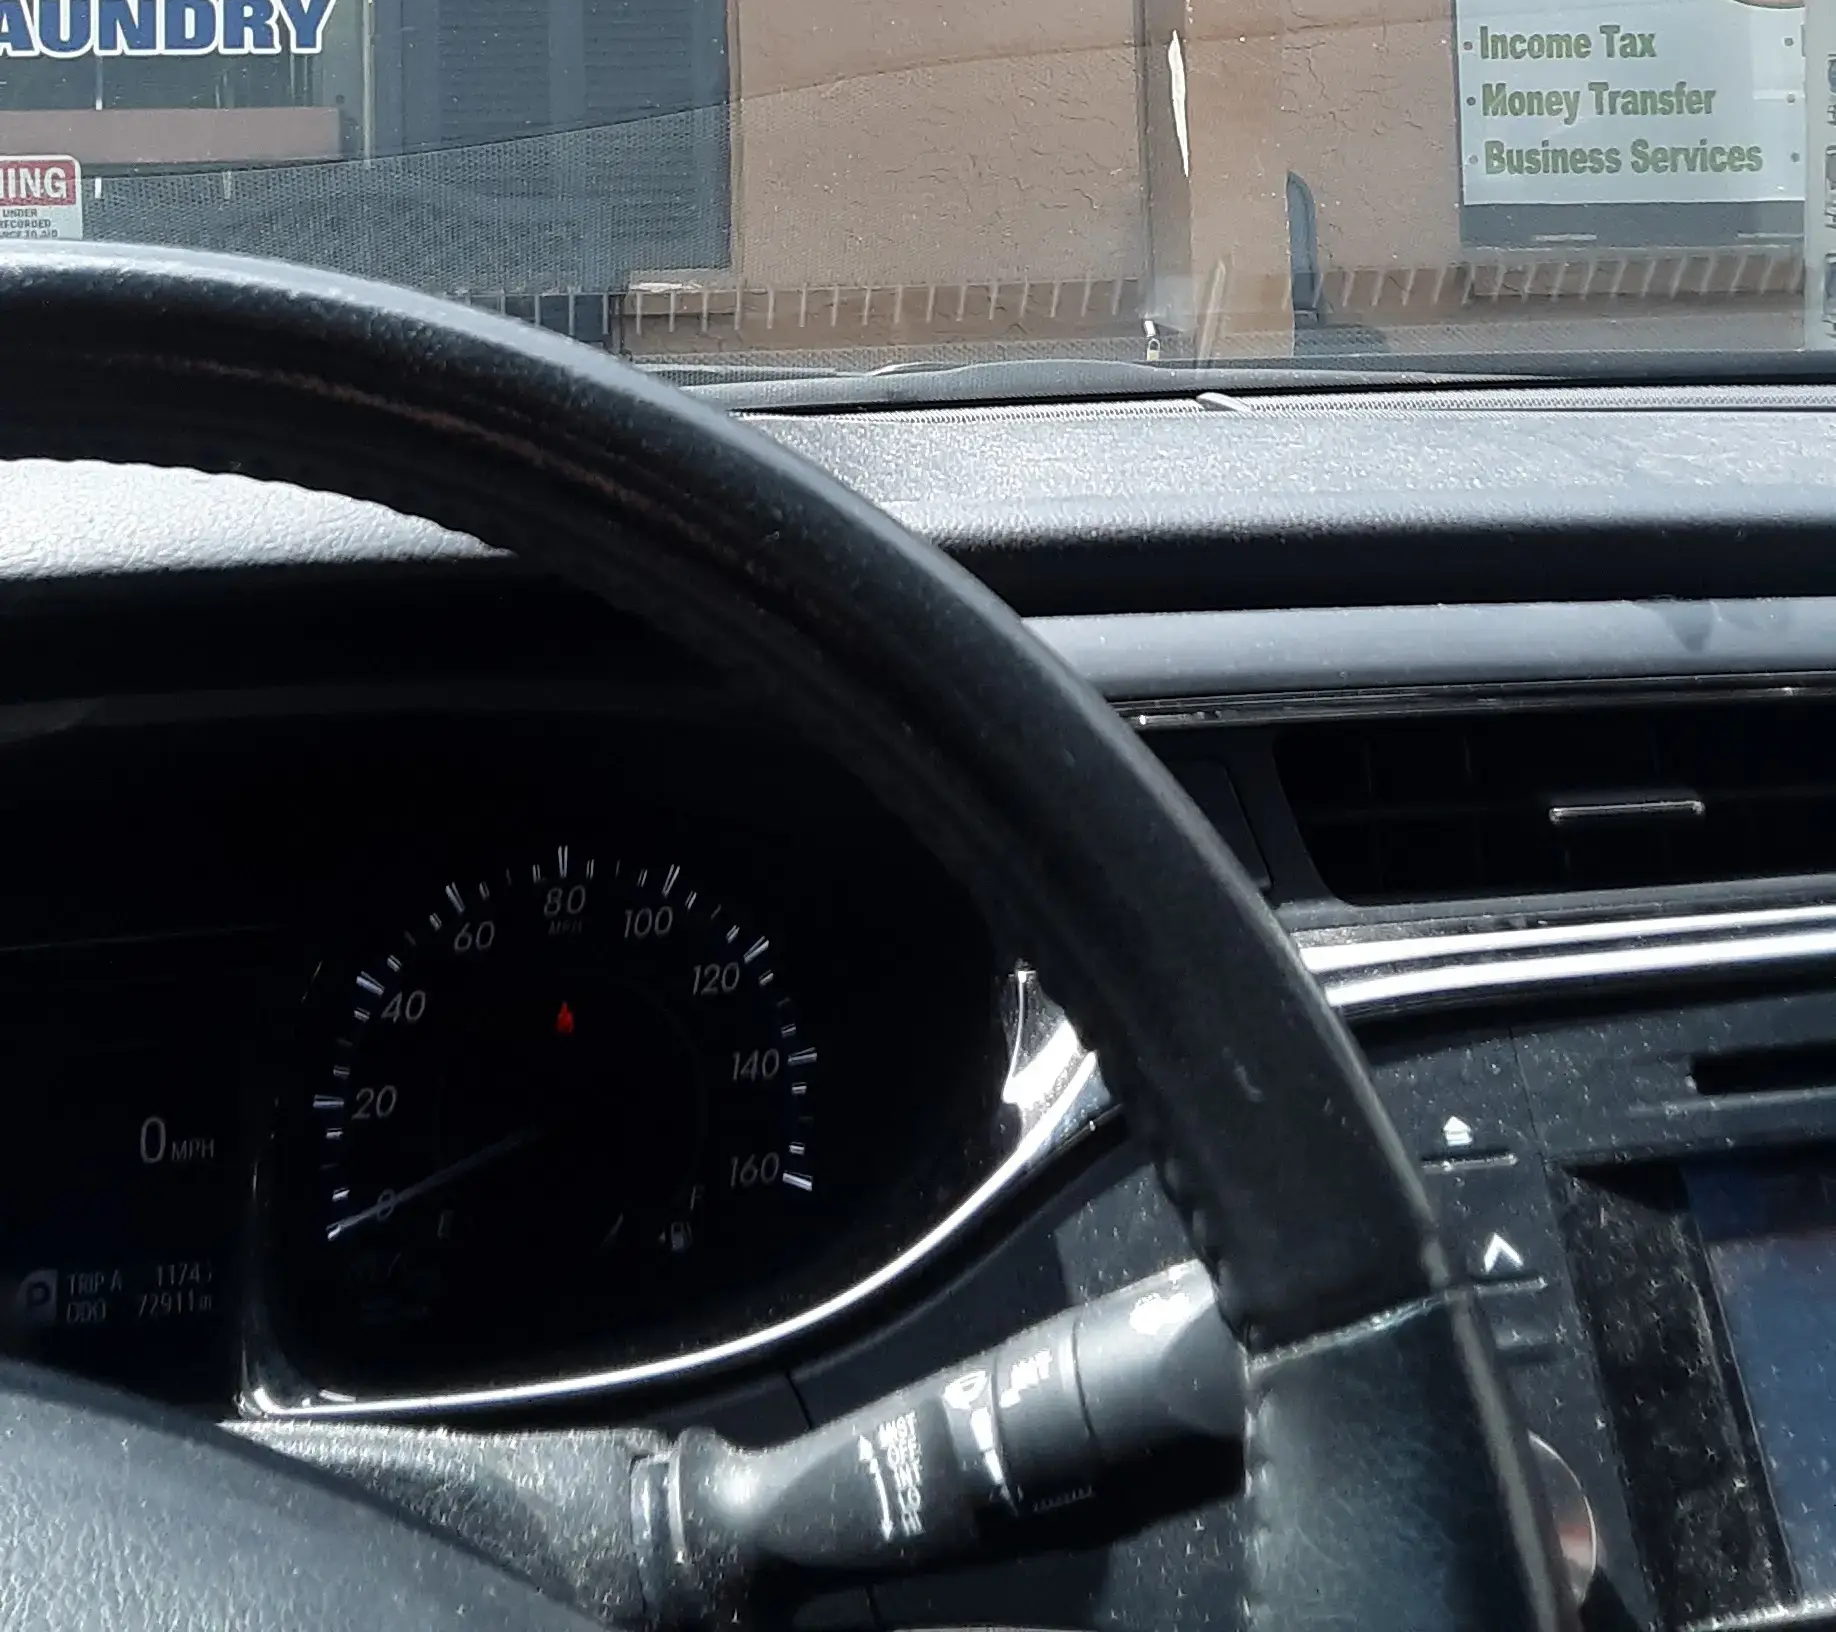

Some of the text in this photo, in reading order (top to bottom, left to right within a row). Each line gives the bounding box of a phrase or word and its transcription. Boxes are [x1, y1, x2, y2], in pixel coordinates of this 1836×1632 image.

[1479, 24, 1657, 59] Income Tax
[1481, 81, 1716, 125] Money Transfer
[1484, 138, 1764, 175] Business Services
[0, 167, 67, 199] ING
[543, 883, 587, 918] 80
[453, 920, 496, 952] 60
[623, 904, 674, 939] 100
[692, 961, 740, 996] 120
[381, 990, 427, 1023] 40
[732, 1048, 781, 1082] 140
[351, 1084, 398, 1120] 20
[140, 1115, 215, 1164] 0 MPH
[729, 1151, 780, 1188] 160
